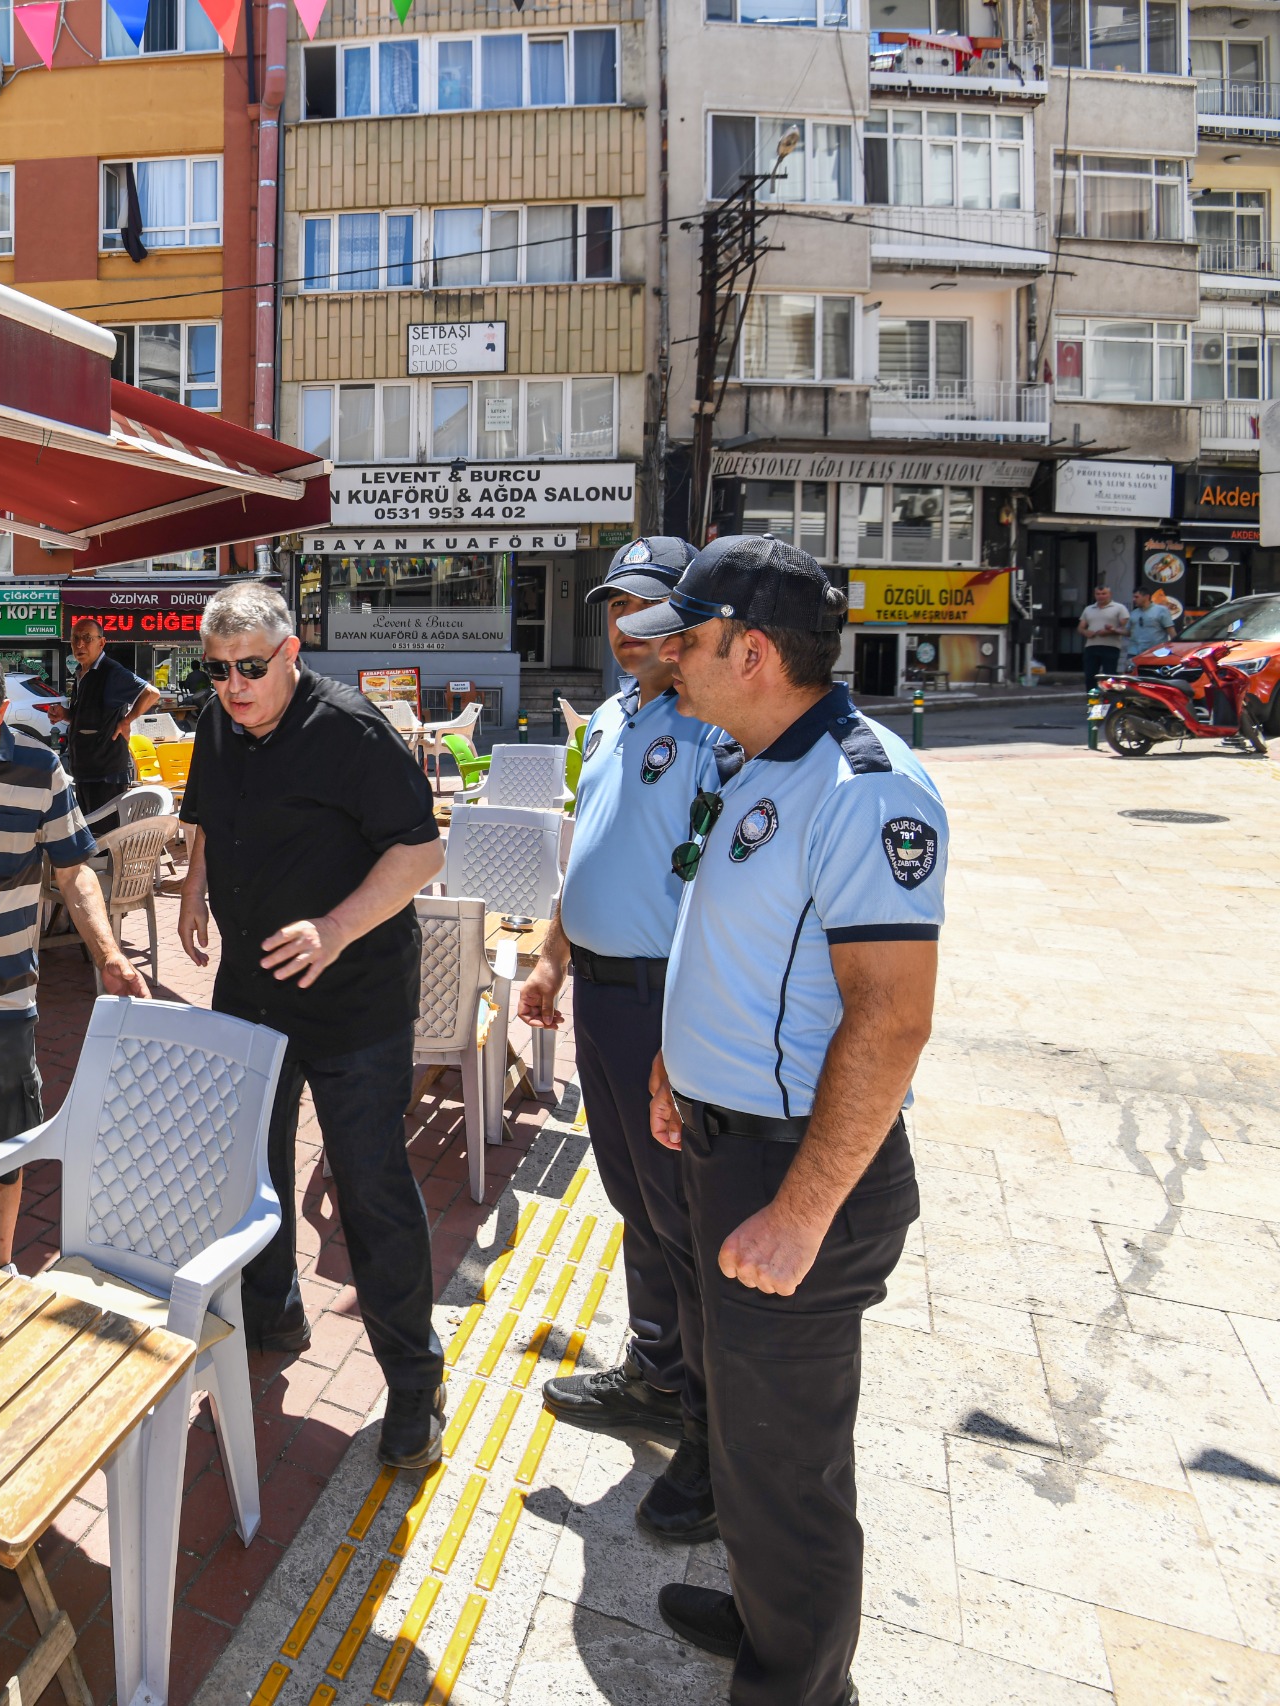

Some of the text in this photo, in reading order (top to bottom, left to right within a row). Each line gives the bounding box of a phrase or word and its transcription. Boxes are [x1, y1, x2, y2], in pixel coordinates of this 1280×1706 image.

[412, 325, 470, 340] SETBAŞI
[412, 343, 457, 356] PILATES
[412, 359, 457, 372] STUDIO
[807, 456, 844, 477] AĞDA
[848, 460, 866, 478] VE
[867, 460, 896, 481] KAŞ
[898, 462, 933, 480] ALIM
[362, 470, 540, 484] LEVENT & BURCU
[348, 486, 449, 504] KUAFÖRÜ
[457, 488, 472, 502] &
[479, 484, 537, 502] AĞDA
[544, 486, 632, 502] SALONU
[374, 507, 525, 520] 0531 953 44 02
[314, 538, 407, 551] BAYAN
[423, 534, 566, 550] KUAFÖRÜ
[4, 592, 58, 601] ÇİĞKÖFTE
[110, 593, 158, 604] ÖZDİYAR
[884, 584, 934, 606] ÖZGÜL
[939, 589, 974, 606] GIDA
[373, 615, 463, 628] Levent & Burcu
[876, 610, 968, 622] TEKEL-MEŞRUBAT
[335, 632, 367, 640] BAYAN
[370, 630, 418, 640] KUAFÖRÜ
[430, 630, 459, 639] AĞDA
[462, 631, 503, 639] SALONU
[890, 821, 922, 834] BURSA
[913, 839, 934, 880] BELEDİYESİ
